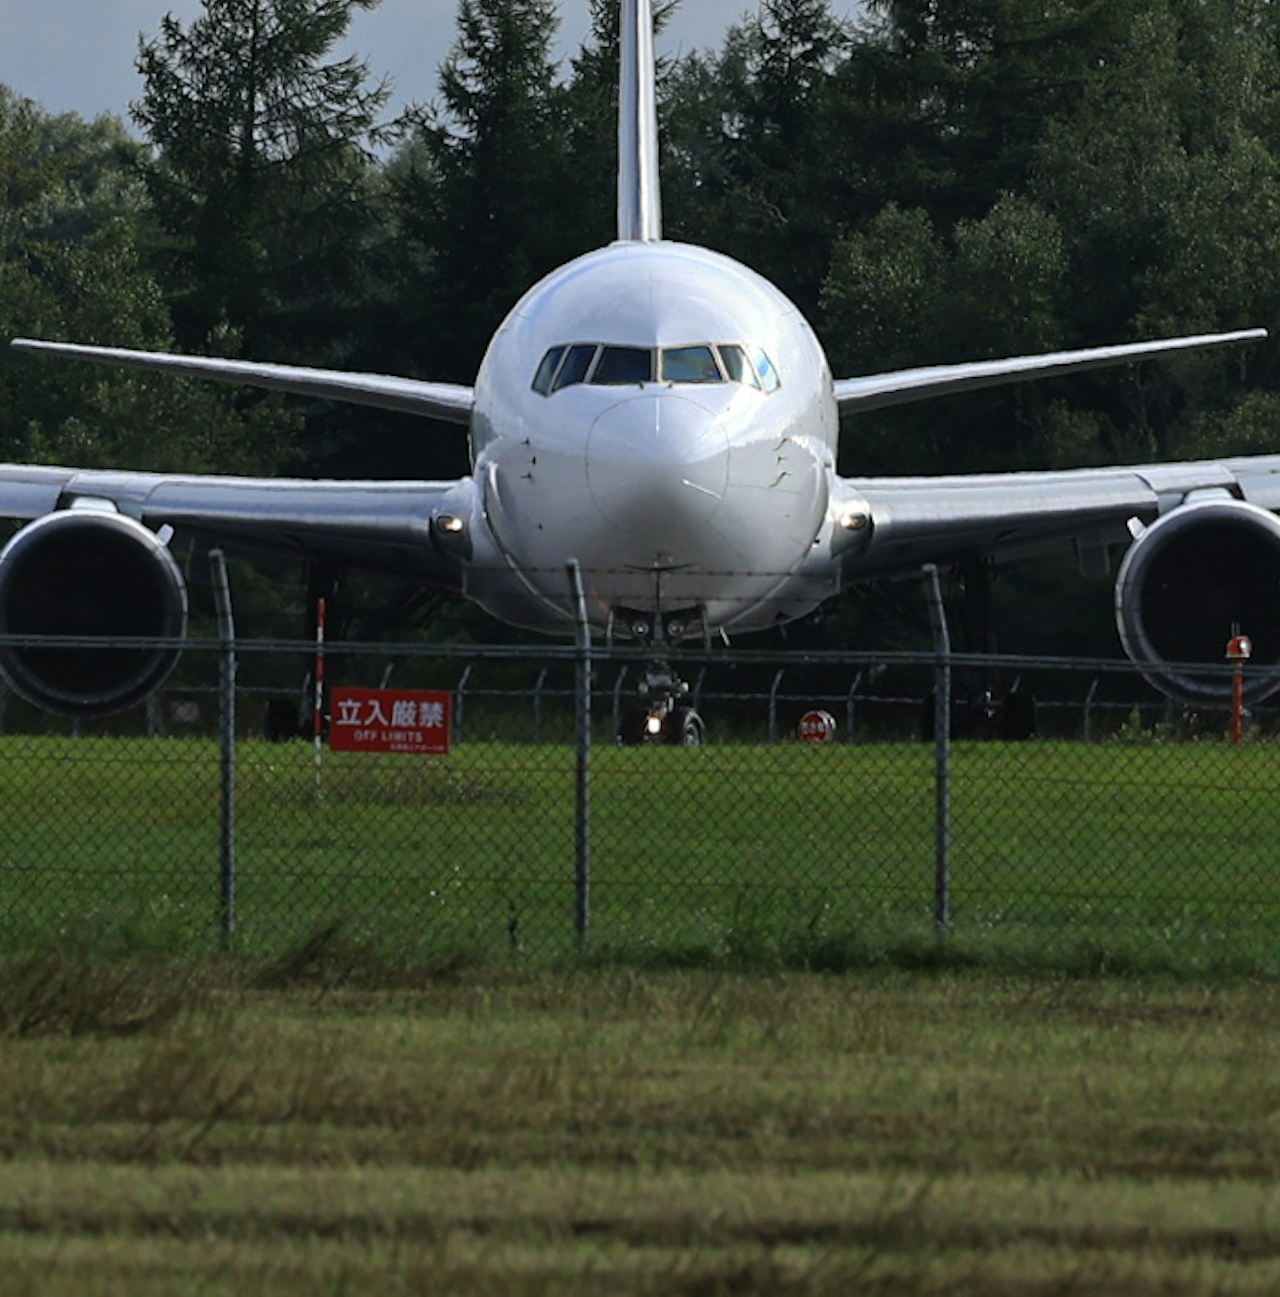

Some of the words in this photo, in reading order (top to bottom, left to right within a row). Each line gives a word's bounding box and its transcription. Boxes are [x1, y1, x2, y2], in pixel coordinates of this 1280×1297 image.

[336, 699, 443, 727] 立入厳禁
[353, 730, 377, 741] OFF
[381, 731, 423, 742] LIMITS
